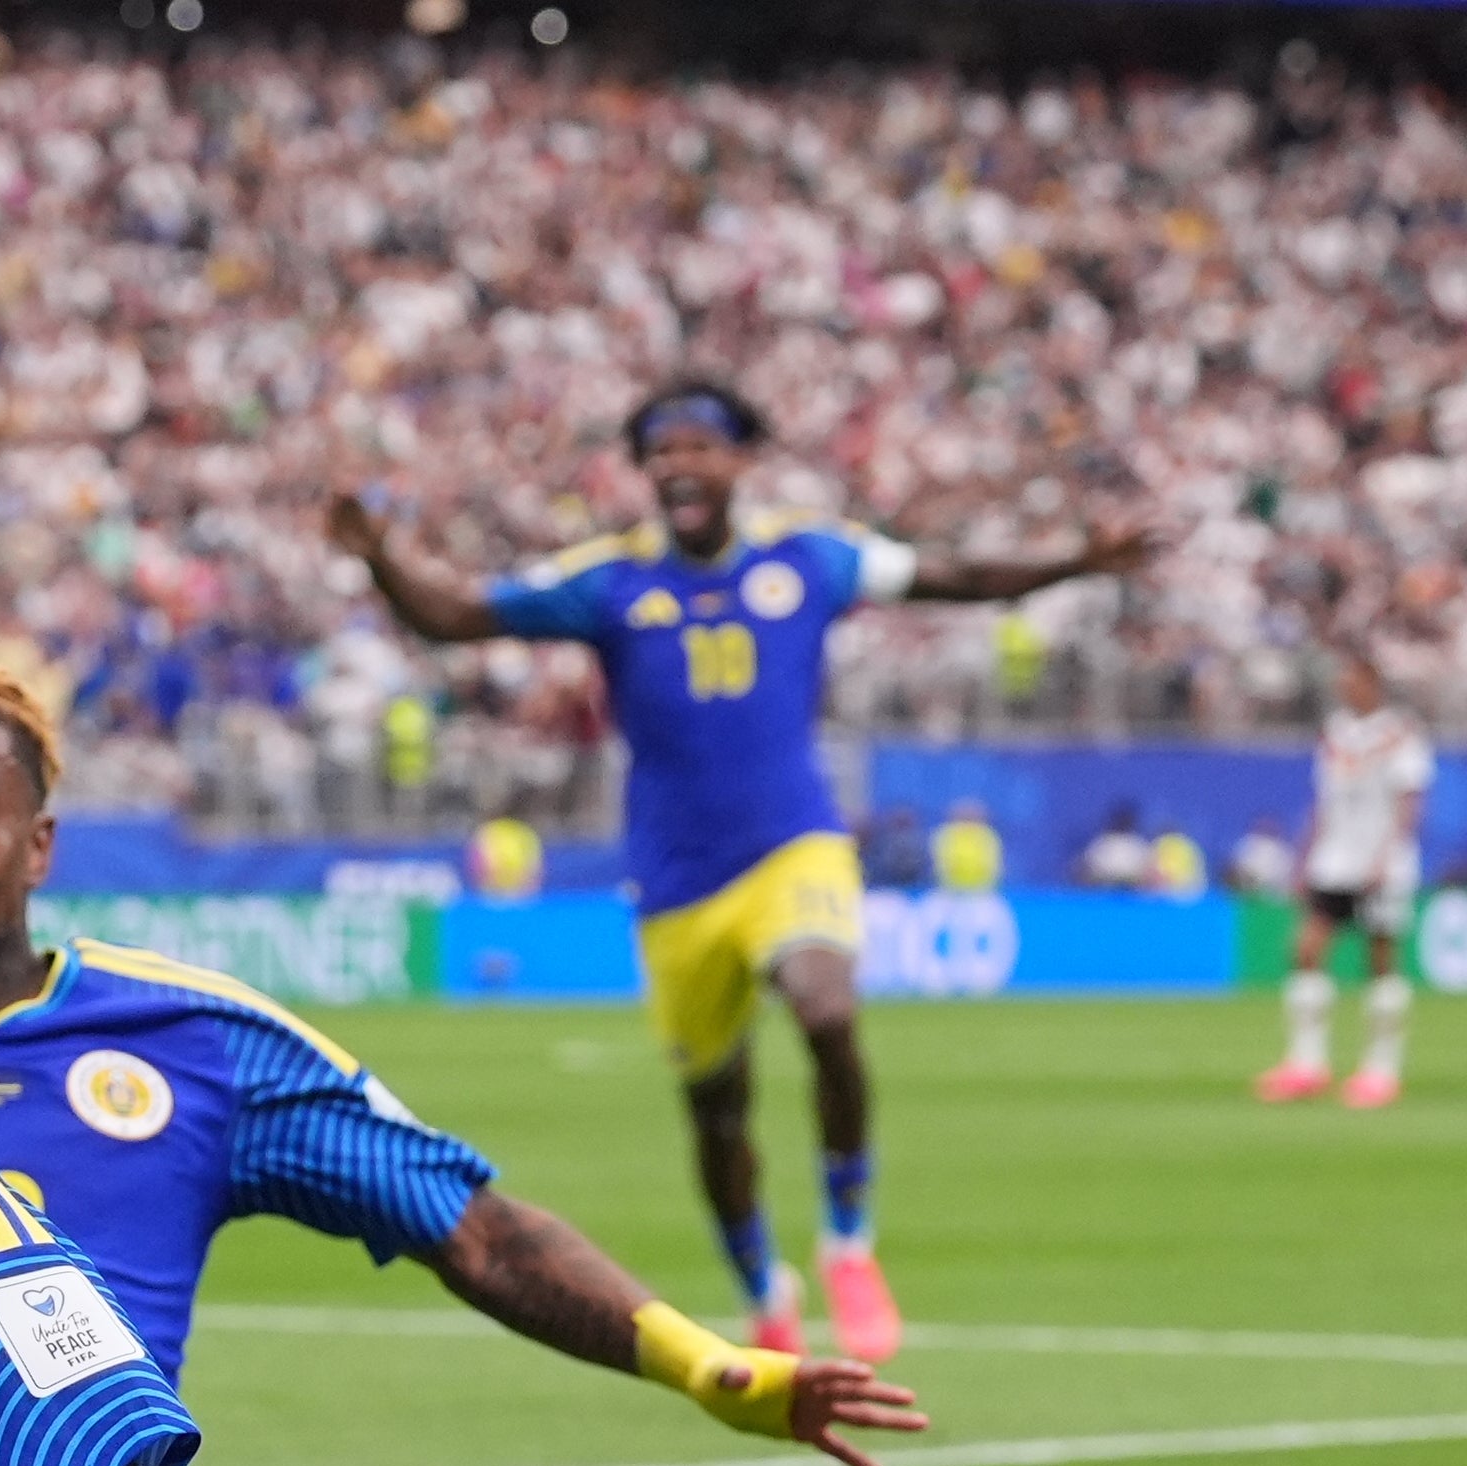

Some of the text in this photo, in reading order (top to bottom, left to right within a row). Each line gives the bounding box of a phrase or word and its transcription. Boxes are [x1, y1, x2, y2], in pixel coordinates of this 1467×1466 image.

[31, 1310, 91, 1343] Unite For
[45, 1328, 102, 1360] PEACE
[66, 1350, 97, 1368] FIFA
